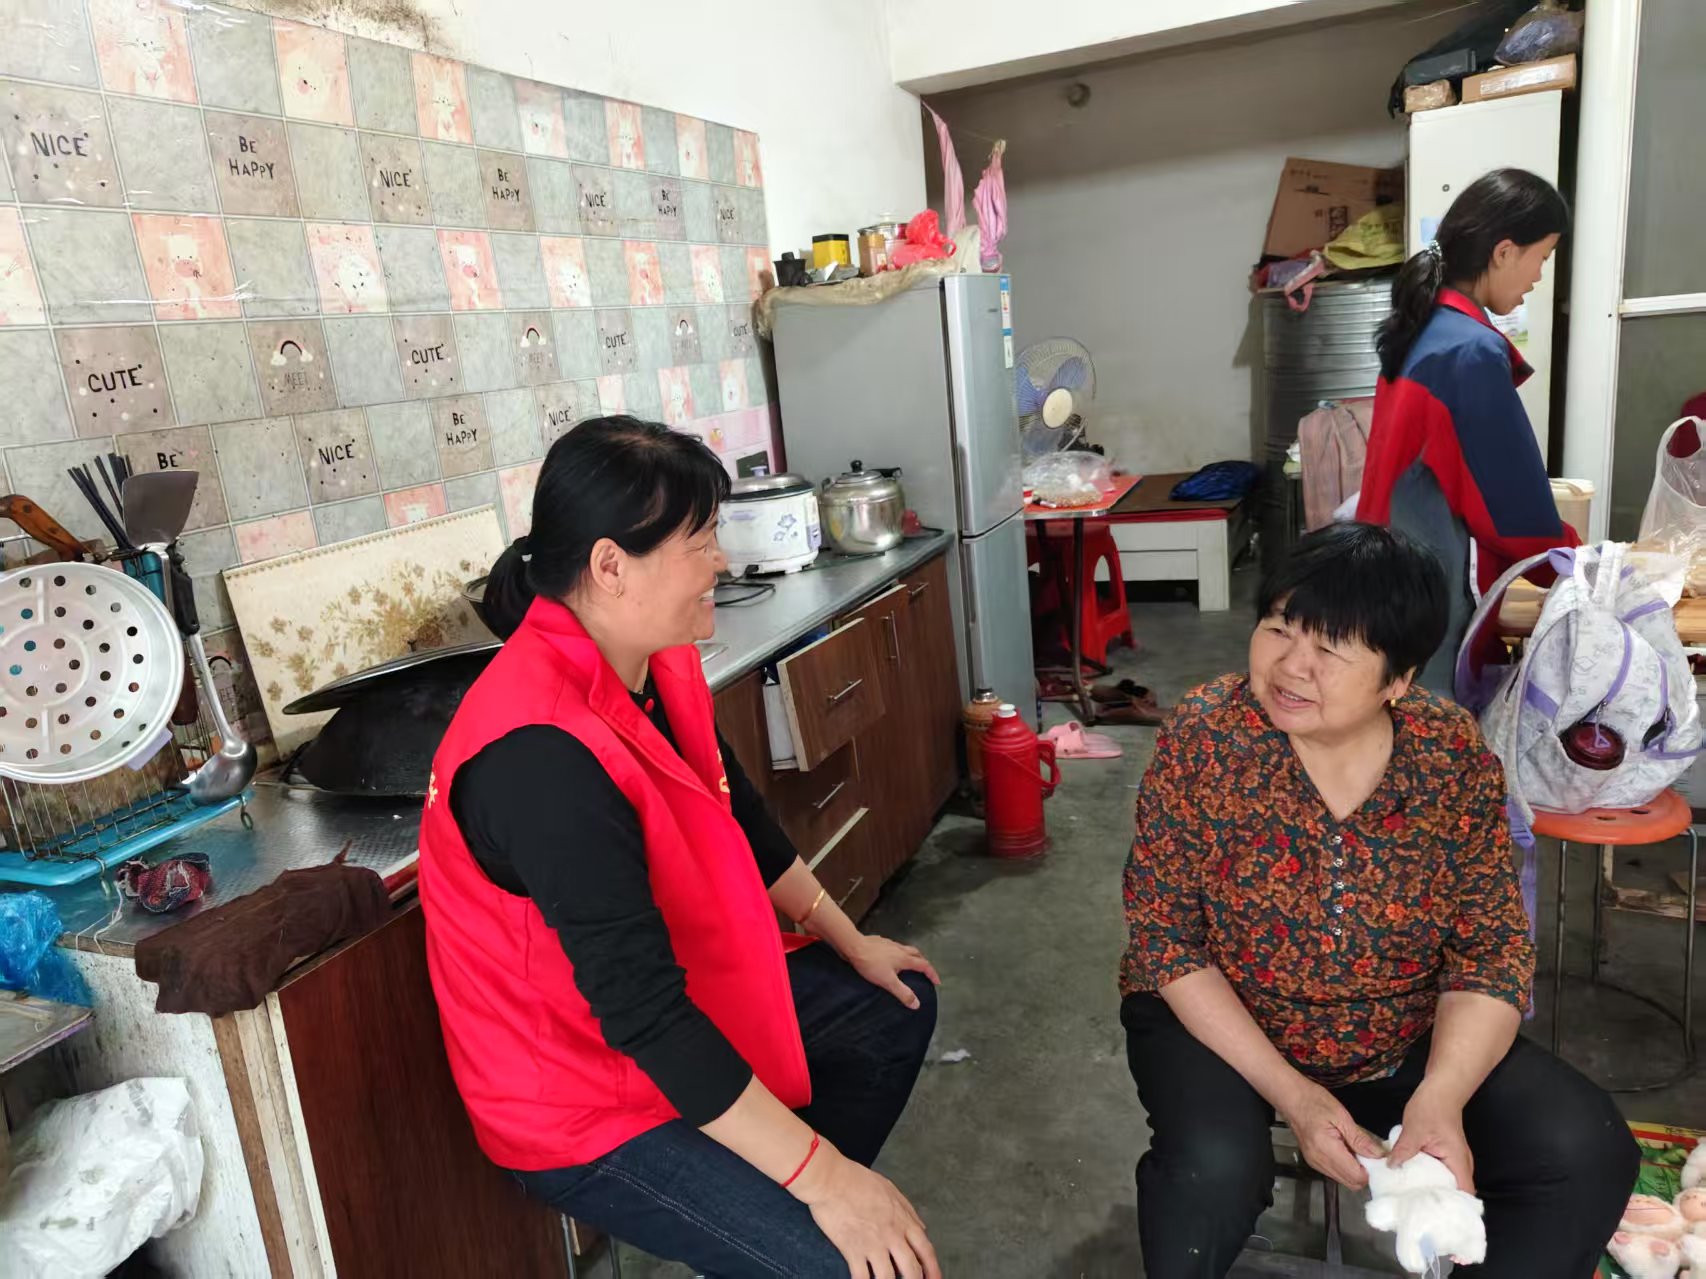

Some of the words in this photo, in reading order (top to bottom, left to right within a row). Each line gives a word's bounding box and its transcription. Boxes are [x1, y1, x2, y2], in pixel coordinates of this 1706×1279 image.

[31, 132, 88, 157] NICE
[239, 136, 257, 153] BE
[229, 159, 274, 179] HAPPY
[498, 169, 509, 182] BE
[381, 171, 411, 188] NICE
[492, 186, 520, 201] HAPPY
[586, 193, 605, 207] NICE
[662, 190, 670, 201] BE
[659, 204, 677, 217] HAPPY
[720, 208, 734, 221] NICE
[606, 335, 626, 349] CUTE
[412, 347, 445, 364] CUTE
[88, 366, 142, 393] CUTE
[453, 413, 465, 426] BE
[549, 411, 571, 425] NICE
[446, 429, 477, 445] HAPPY
[157, 453, 178, 469] BE
[319, 443, 353, 464] NICE
